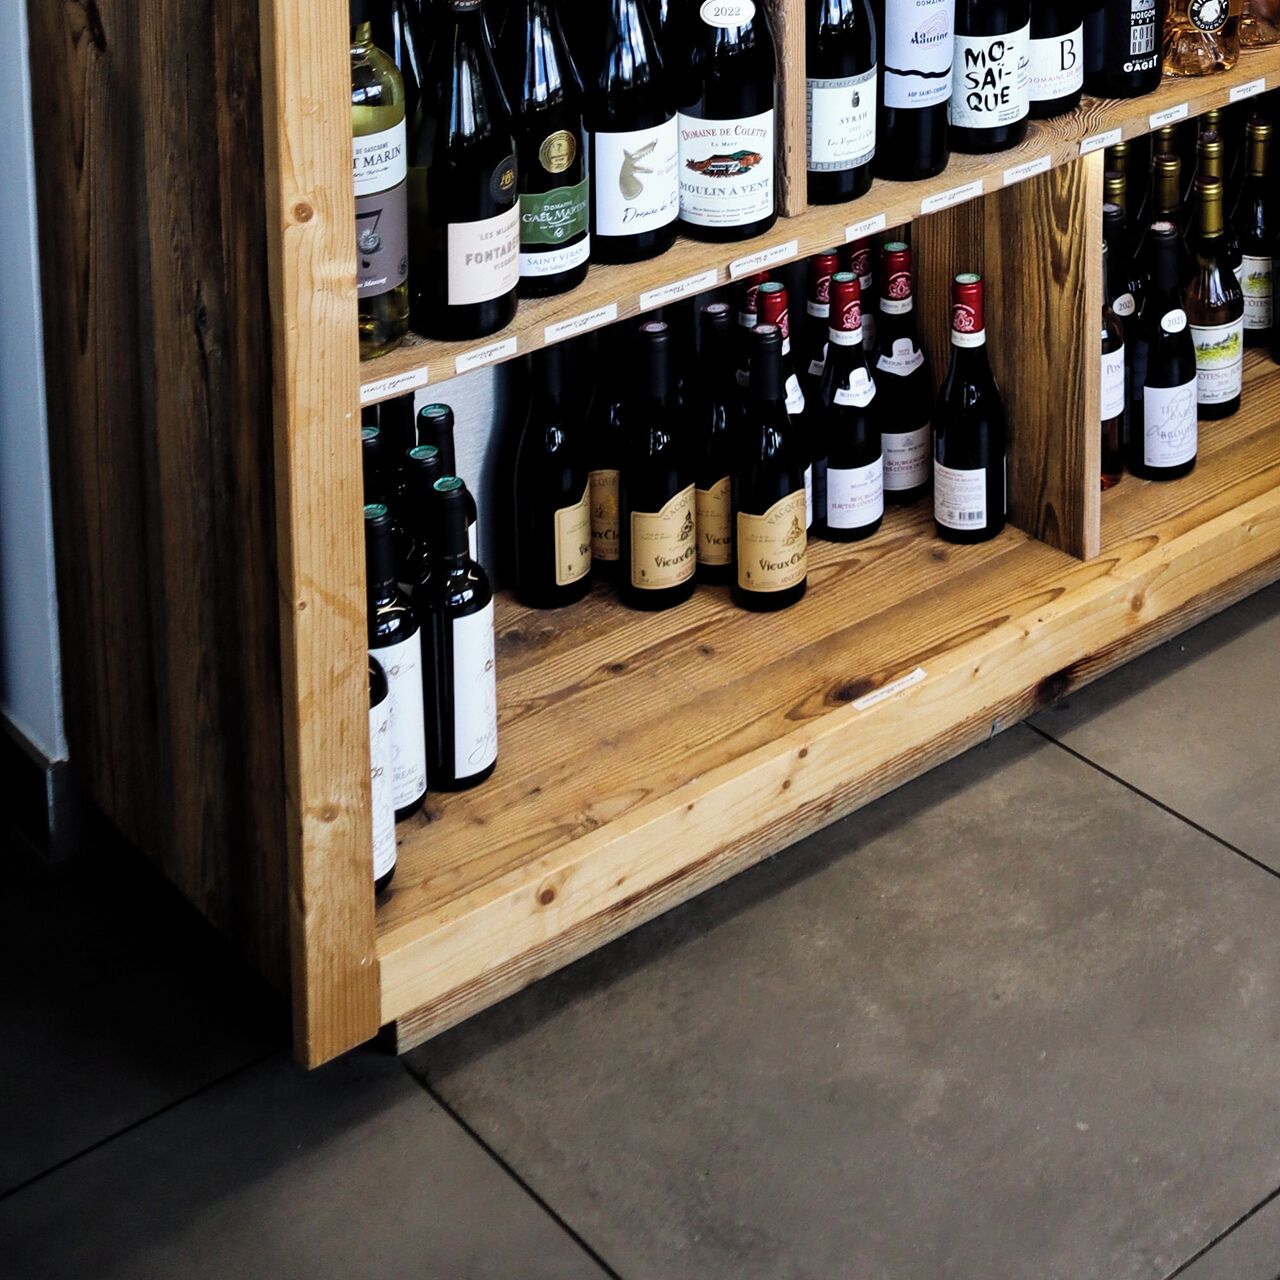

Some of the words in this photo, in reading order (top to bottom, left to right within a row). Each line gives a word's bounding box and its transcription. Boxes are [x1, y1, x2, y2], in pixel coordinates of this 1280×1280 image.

[713, 4, 742, 18] 2022
[1130, 8, 1156, 21] MORGON
[1192, 13, 1226, 30] PROVENCE
[1132, 24, 1155, 39] CÔTE
[1060, 38, 1076, 72] B
[1123, 54, 1159, 73] GAGET
[965, 85, 1010, 112] QUE
[680, 127, 717, 141] DOMAINE
[719, 128, 732, 137] DE
[734, 124, 768, 138] COLETTE
[363, 143, 402, 169] MARIN
[679, 180, 726, 197] MOULIN
[741, 177, 769, 194] VENT
[526, 255, 557, 267] SAINT
[654, 552, 685, 569] Vieux
[759, 558, 790, 572] Vieux
